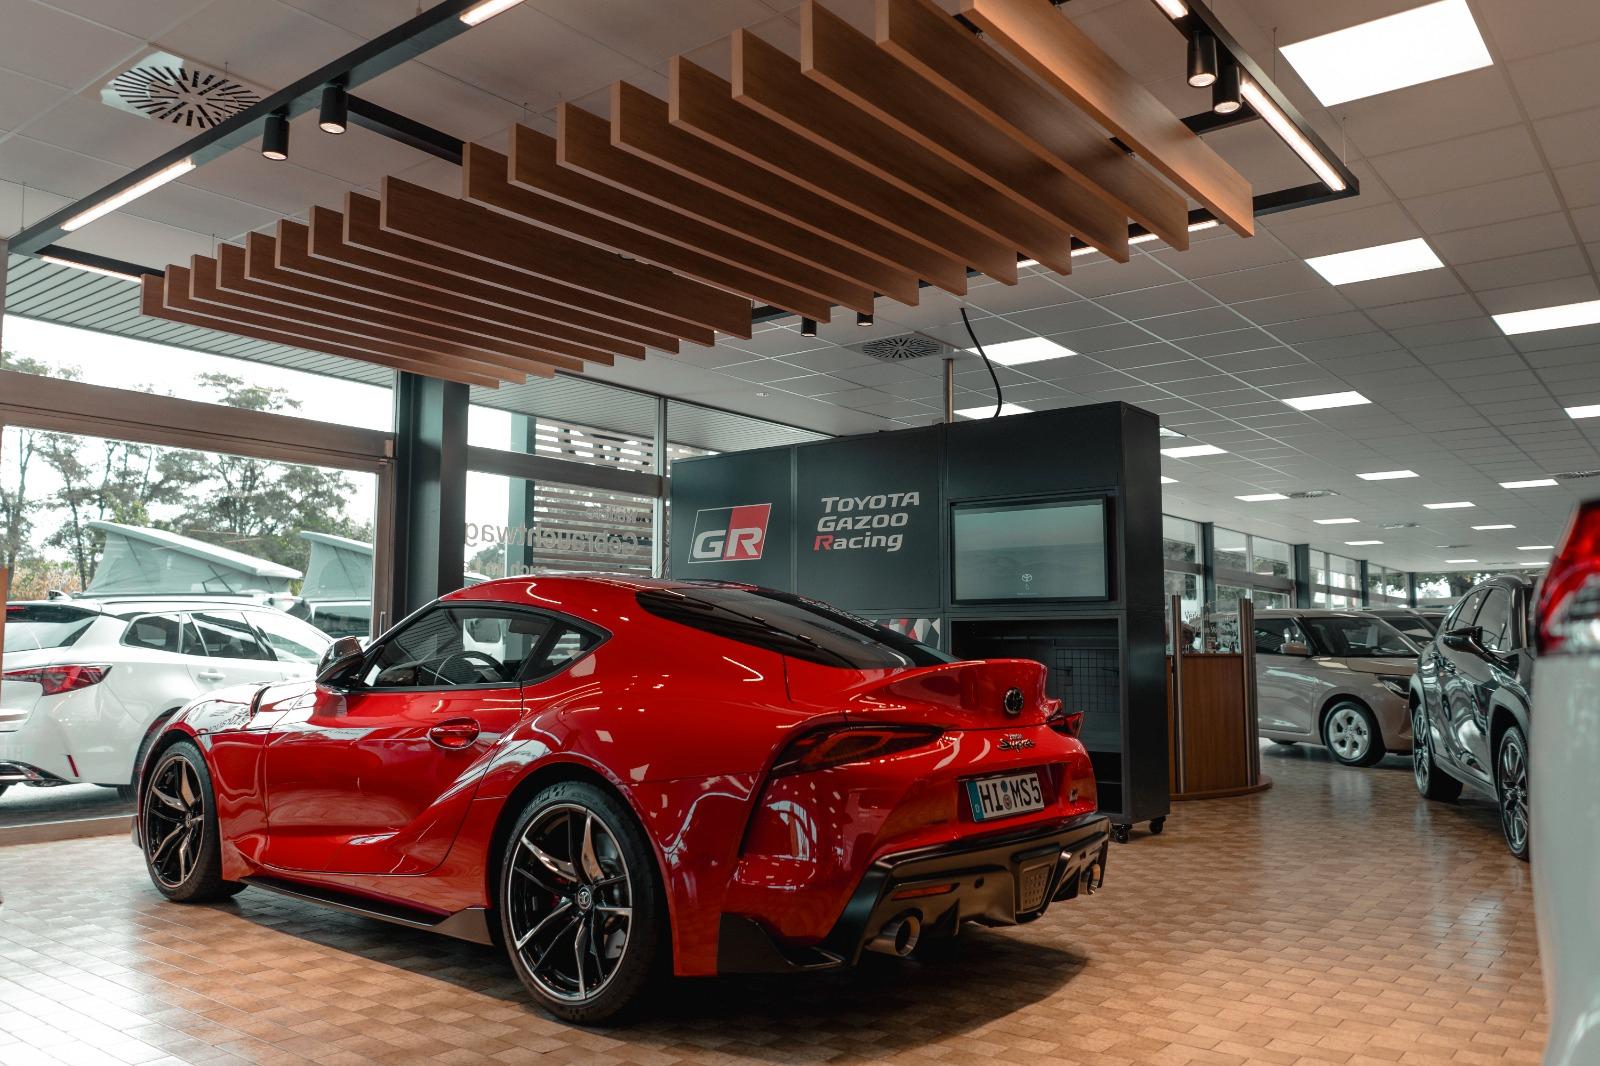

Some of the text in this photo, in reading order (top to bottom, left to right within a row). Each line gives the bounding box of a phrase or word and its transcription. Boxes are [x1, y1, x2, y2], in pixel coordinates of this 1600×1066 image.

[821, 491, 920, 513] TOYOTA
[817, 512, 909, 532] GAZOO
[692, 526, 763, 559] GR
[813, 531, 904, 553] Racing
[979, 783, 1003, 813] HI
